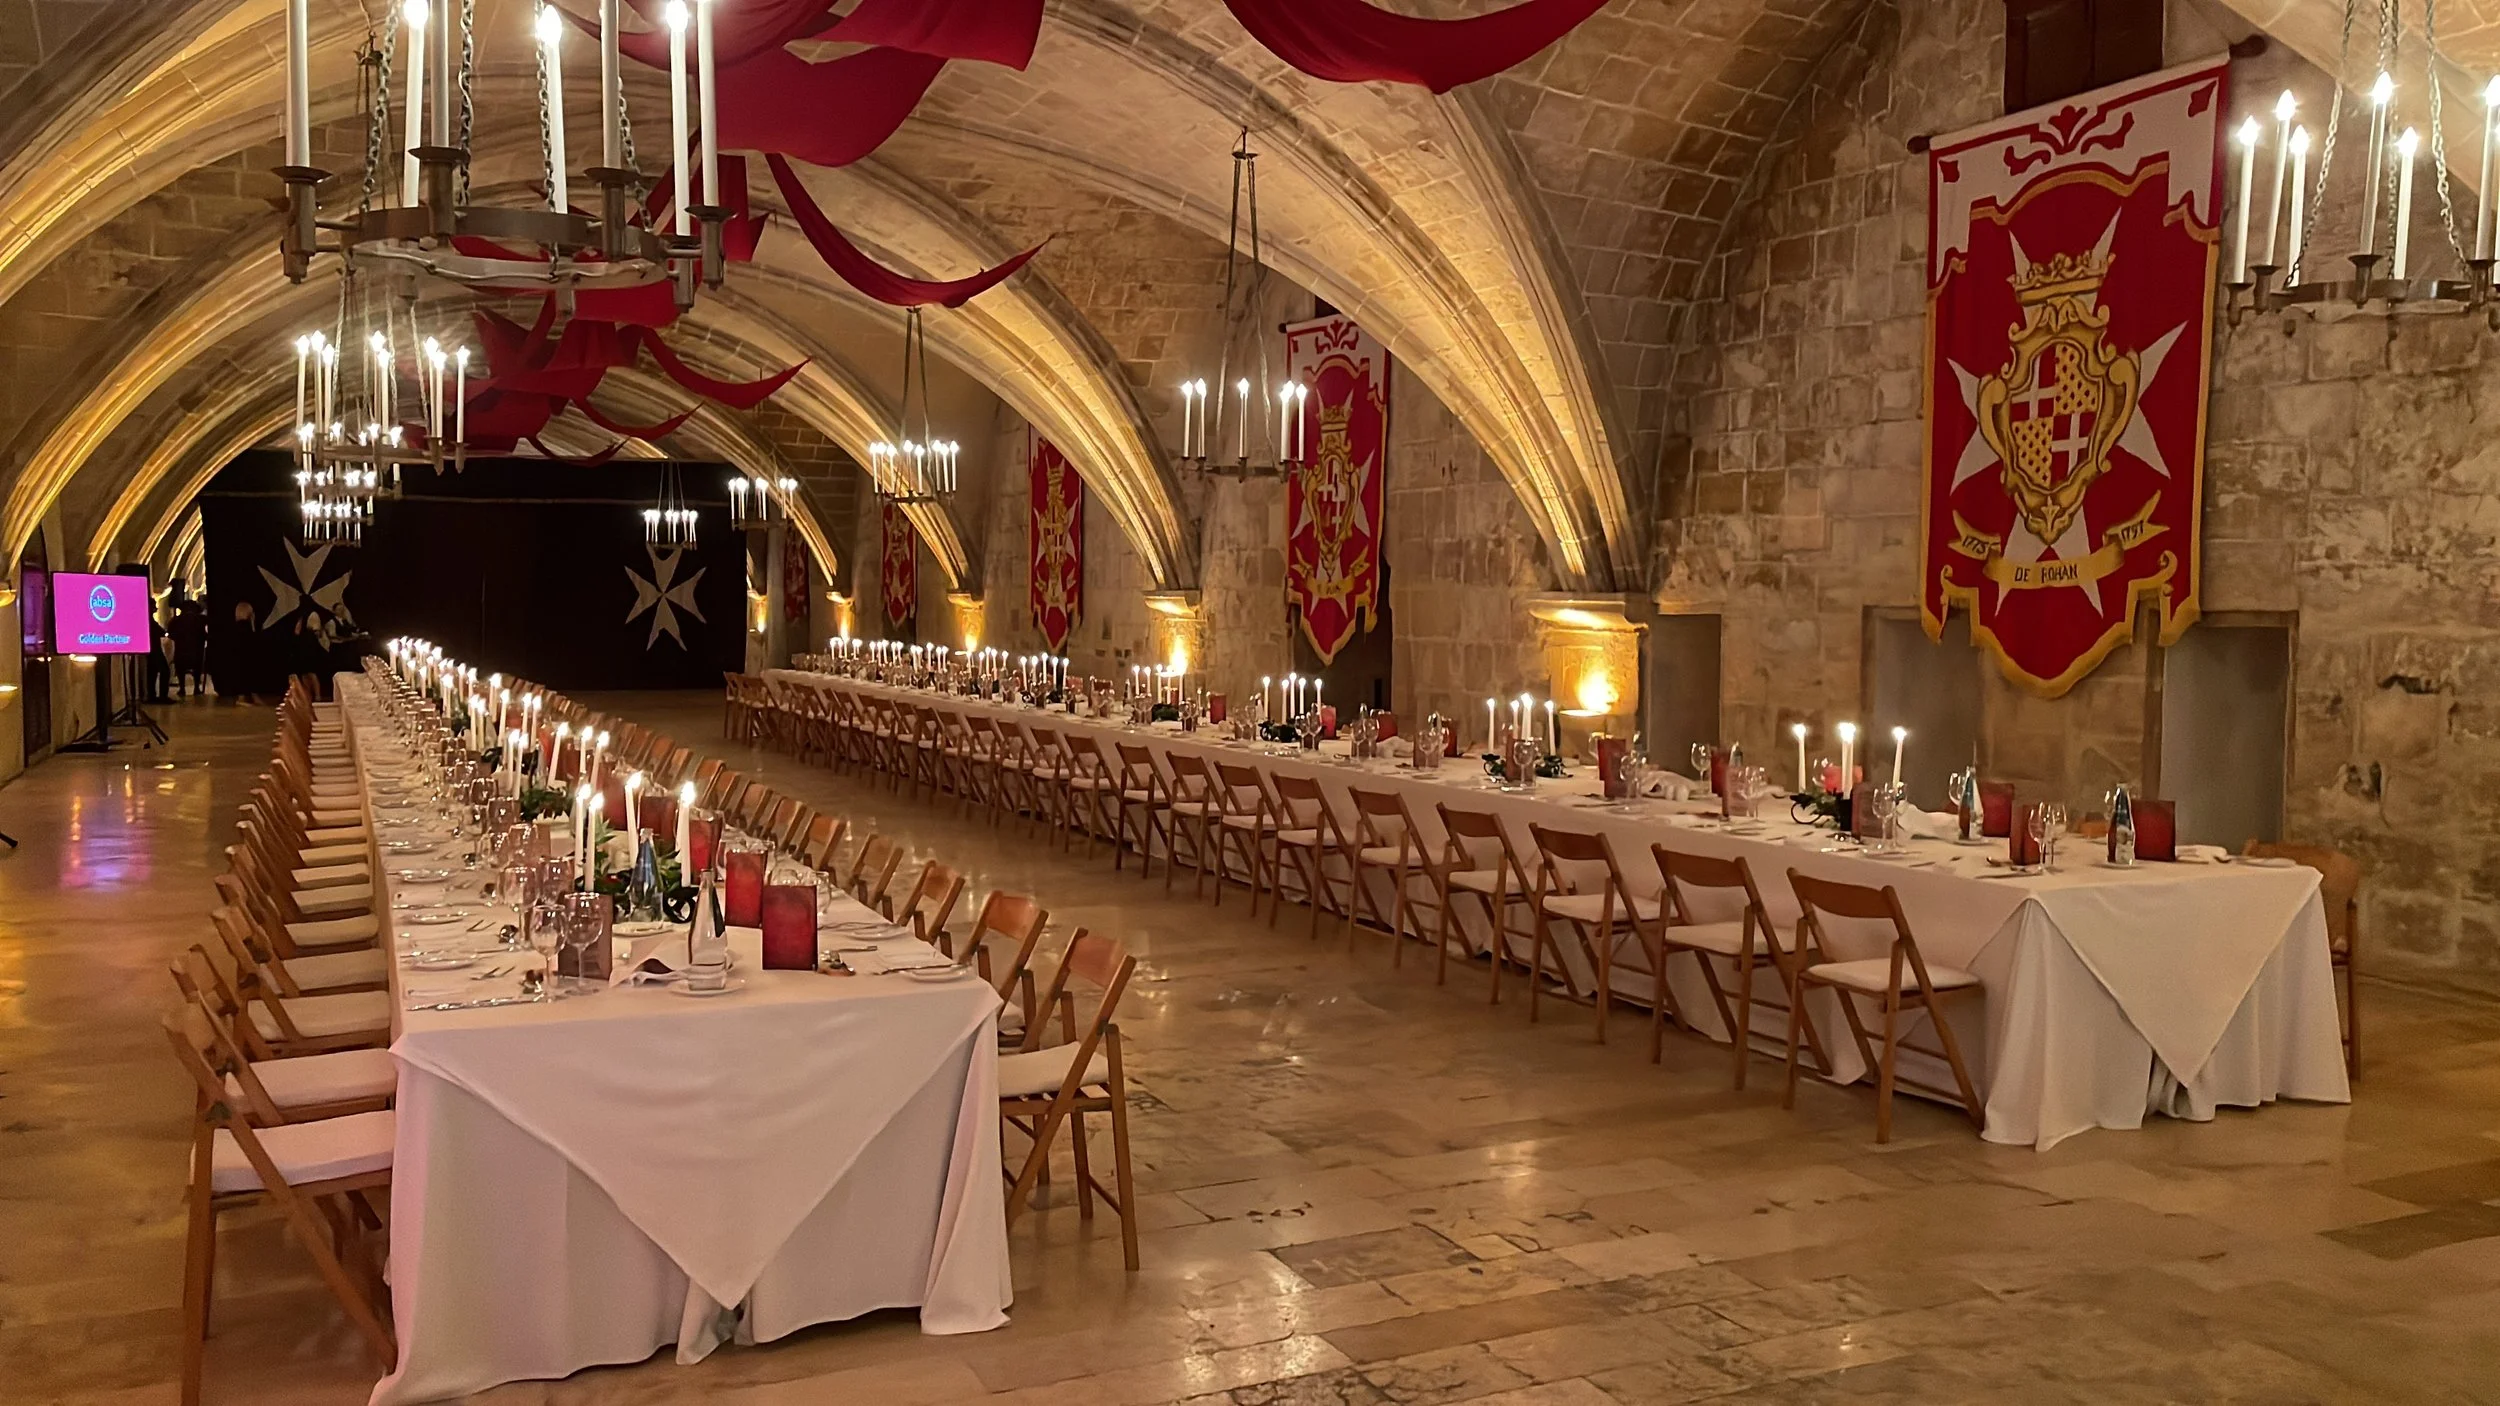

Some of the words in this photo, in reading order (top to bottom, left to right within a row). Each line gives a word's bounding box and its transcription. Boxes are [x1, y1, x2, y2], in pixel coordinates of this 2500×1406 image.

[2121, 519, 2144, 541] 1797
[1962, 535, 1989, 554] 1775
[2014, 566, 2031, 582] DE
[2041, 563, 2078, 584] ROHAN
[92, 595, 112, 608] absa
[79, 633, 103, 644] Golden
[104, 634, 130, 644] Partner
